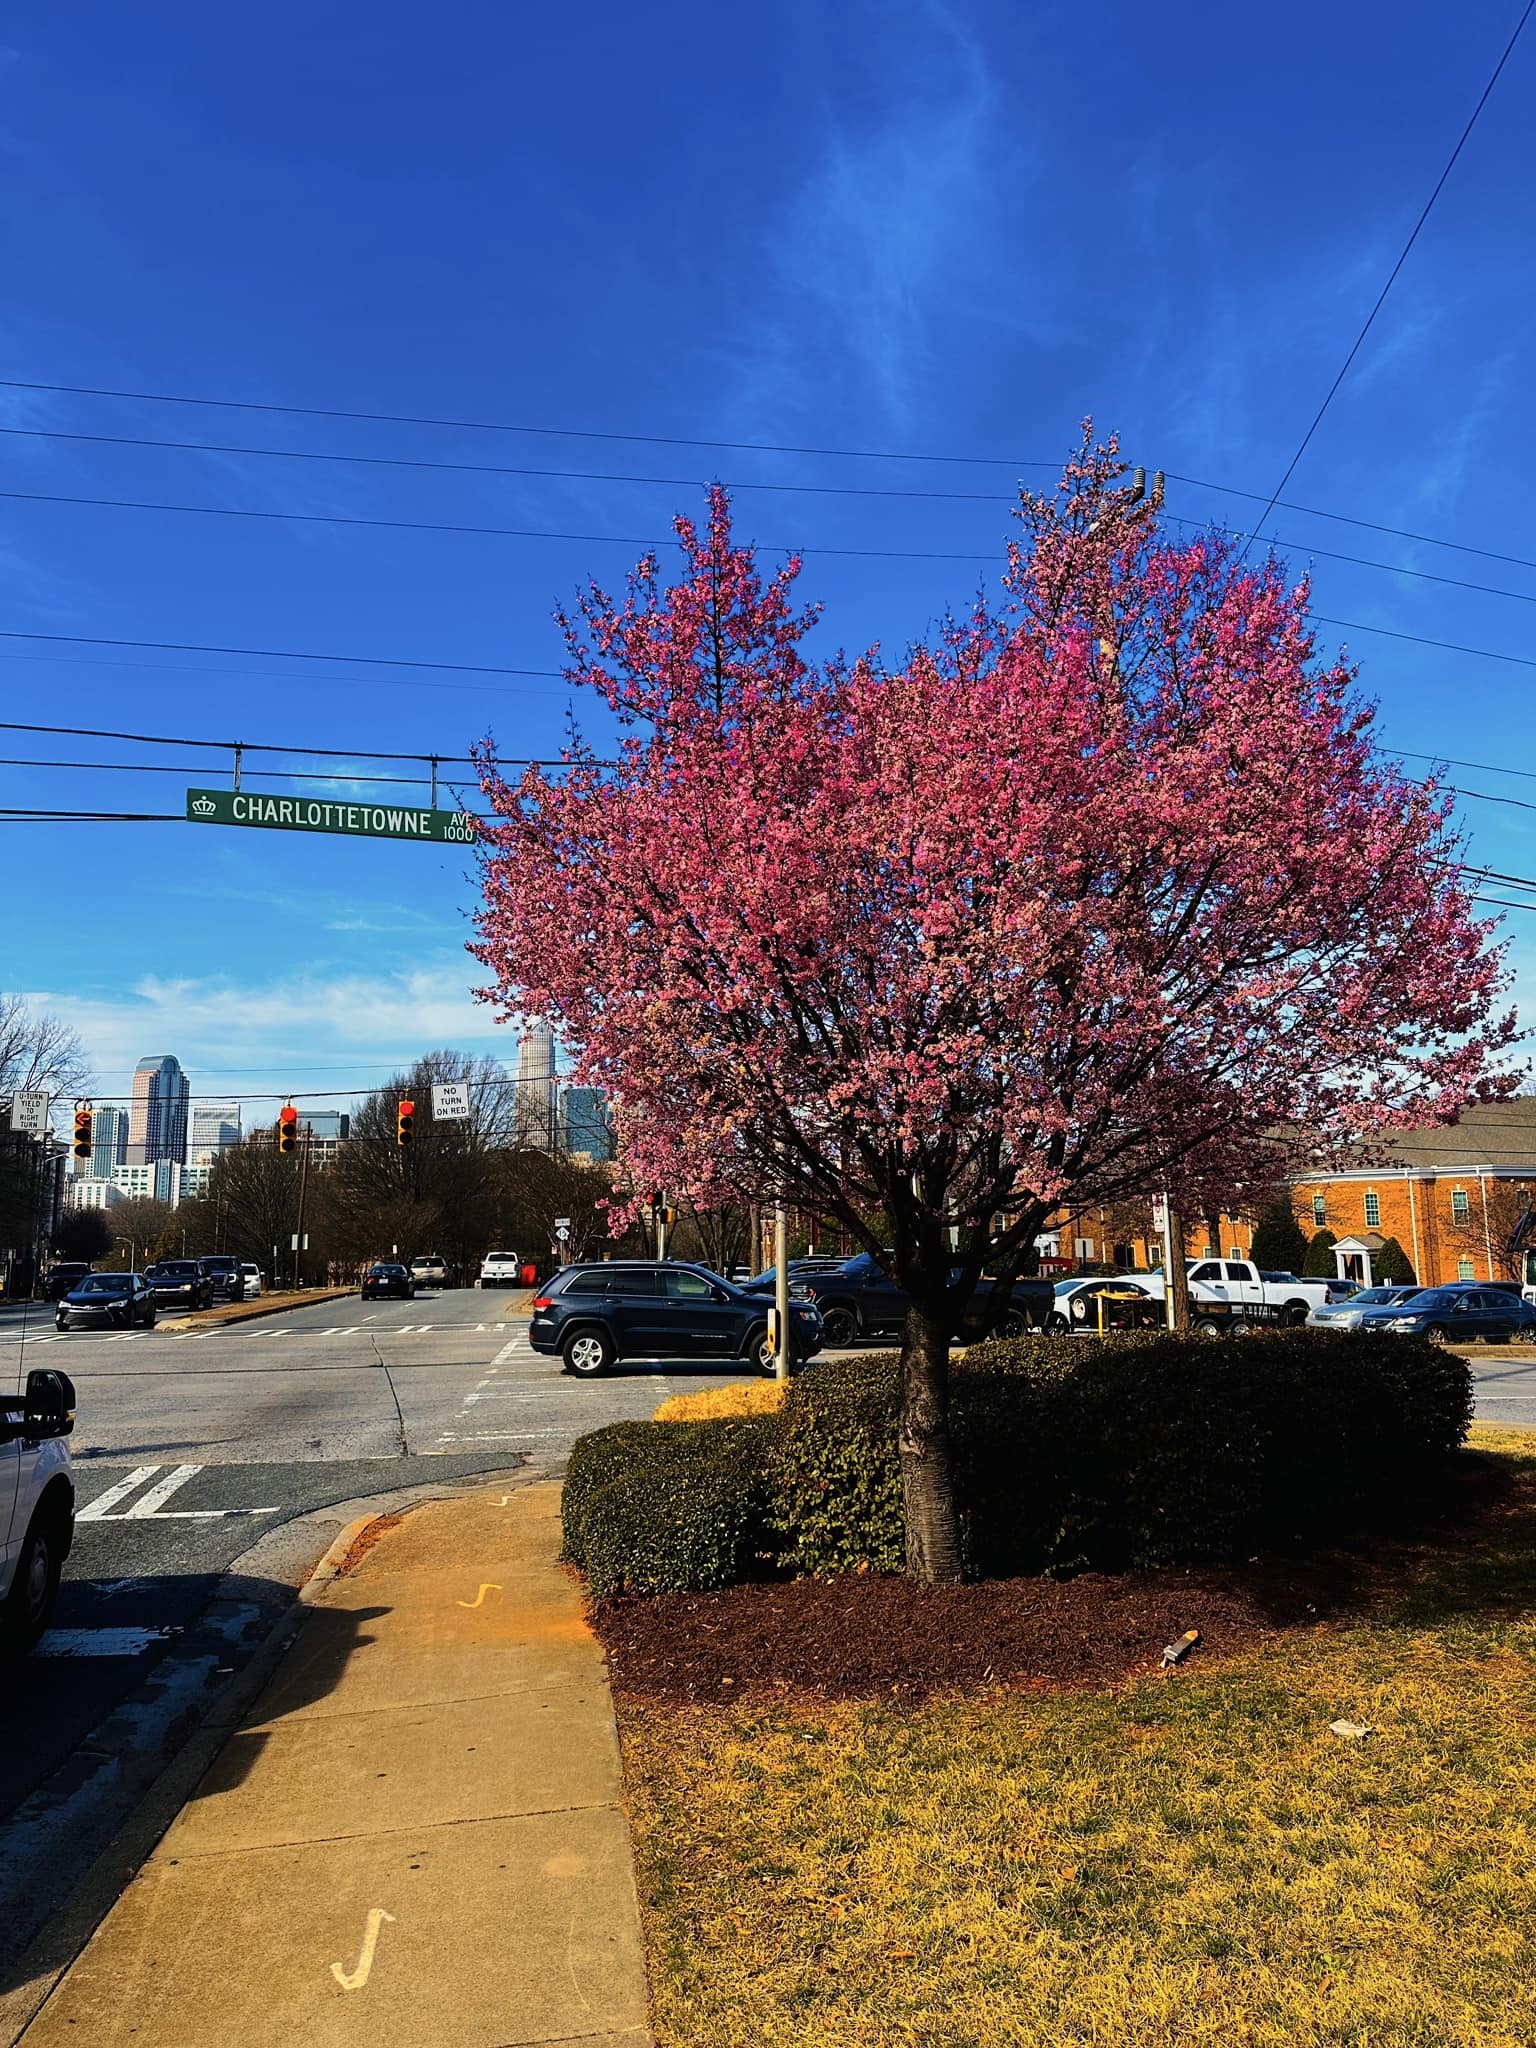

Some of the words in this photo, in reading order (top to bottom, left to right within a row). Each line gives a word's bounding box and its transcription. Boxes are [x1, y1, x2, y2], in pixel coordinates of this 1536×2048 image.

[232, 796, 432, 834] CHARLOTTETOWNE
[443, 825, 473, 841] 1000
[443, 1087, 457, 1095] NO
[440, 1097, 462, 1105] TURN
[436, 1108, 448, 1116] ON
[450, 1106, 467, 1114] RED
